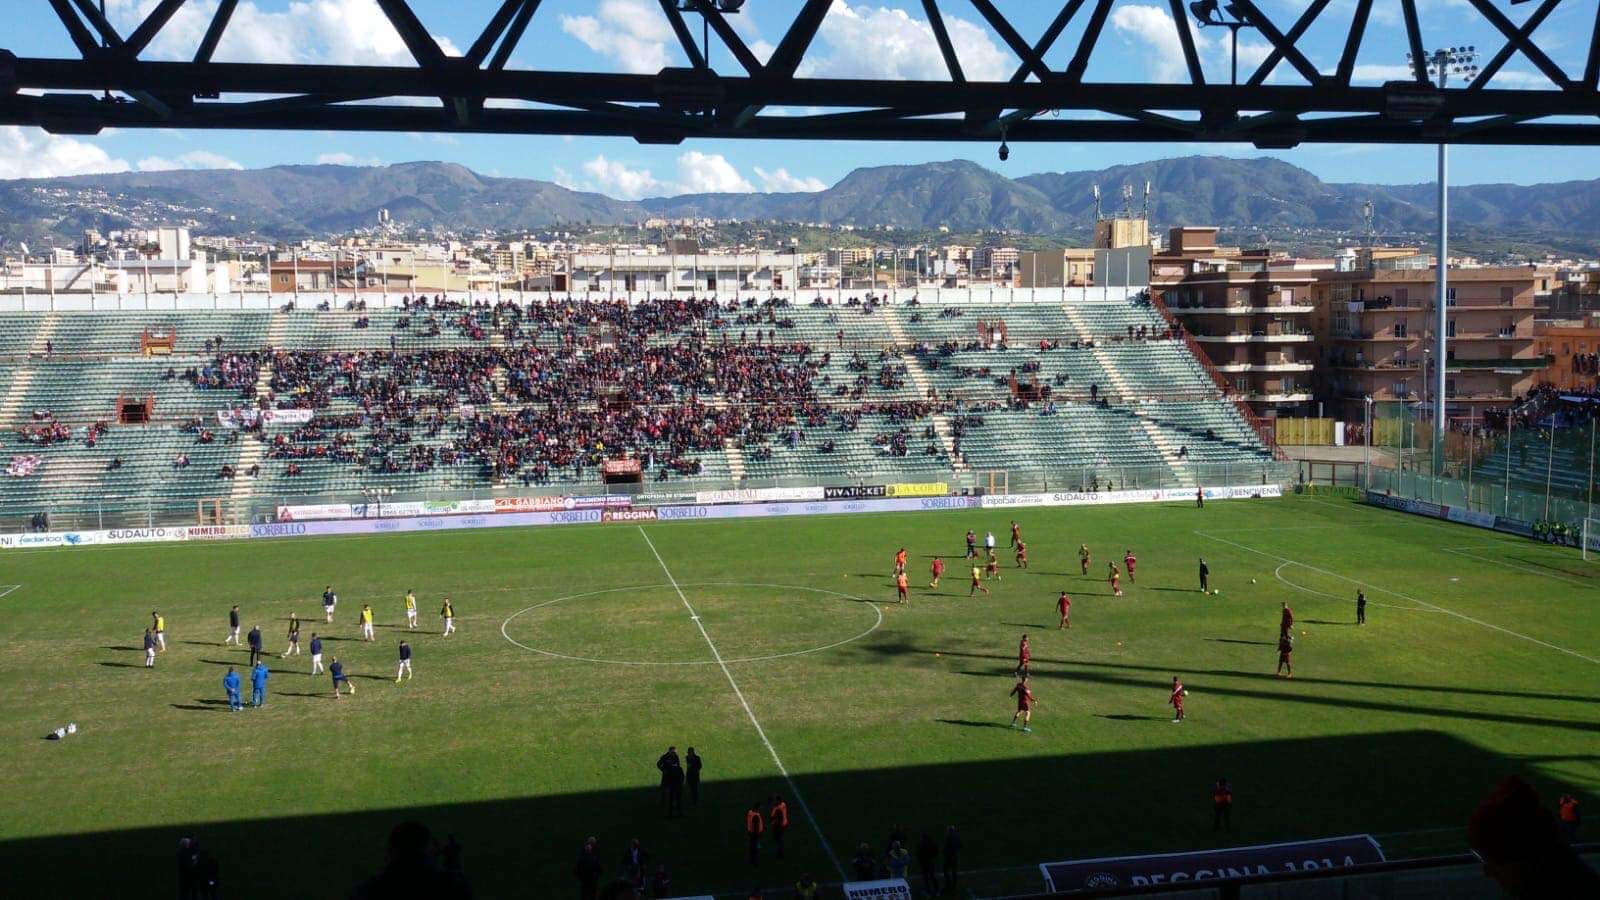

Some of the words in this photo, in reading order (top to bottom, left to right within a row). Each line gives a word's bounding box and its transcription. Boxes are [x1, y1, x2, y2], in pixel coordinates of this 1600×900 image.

[826, 486, 885, 497] VIVATICKET
[920, 497, 966, 509] SORBELLO
[1053, 493, 1098, 502] SUDAUTO
[550, 510, 599, 523] SORBELLO
[612, 510, 656, 520] REGGINA
[660, 507, 707, 519] SORBELLO
[107, 528, 166, 539] SUDAUTO
[188, 527, 226, 536] NUMERO
[252, 523, 306, 537] SORBELLO
[849, 885, 907, 897] NUMERO
